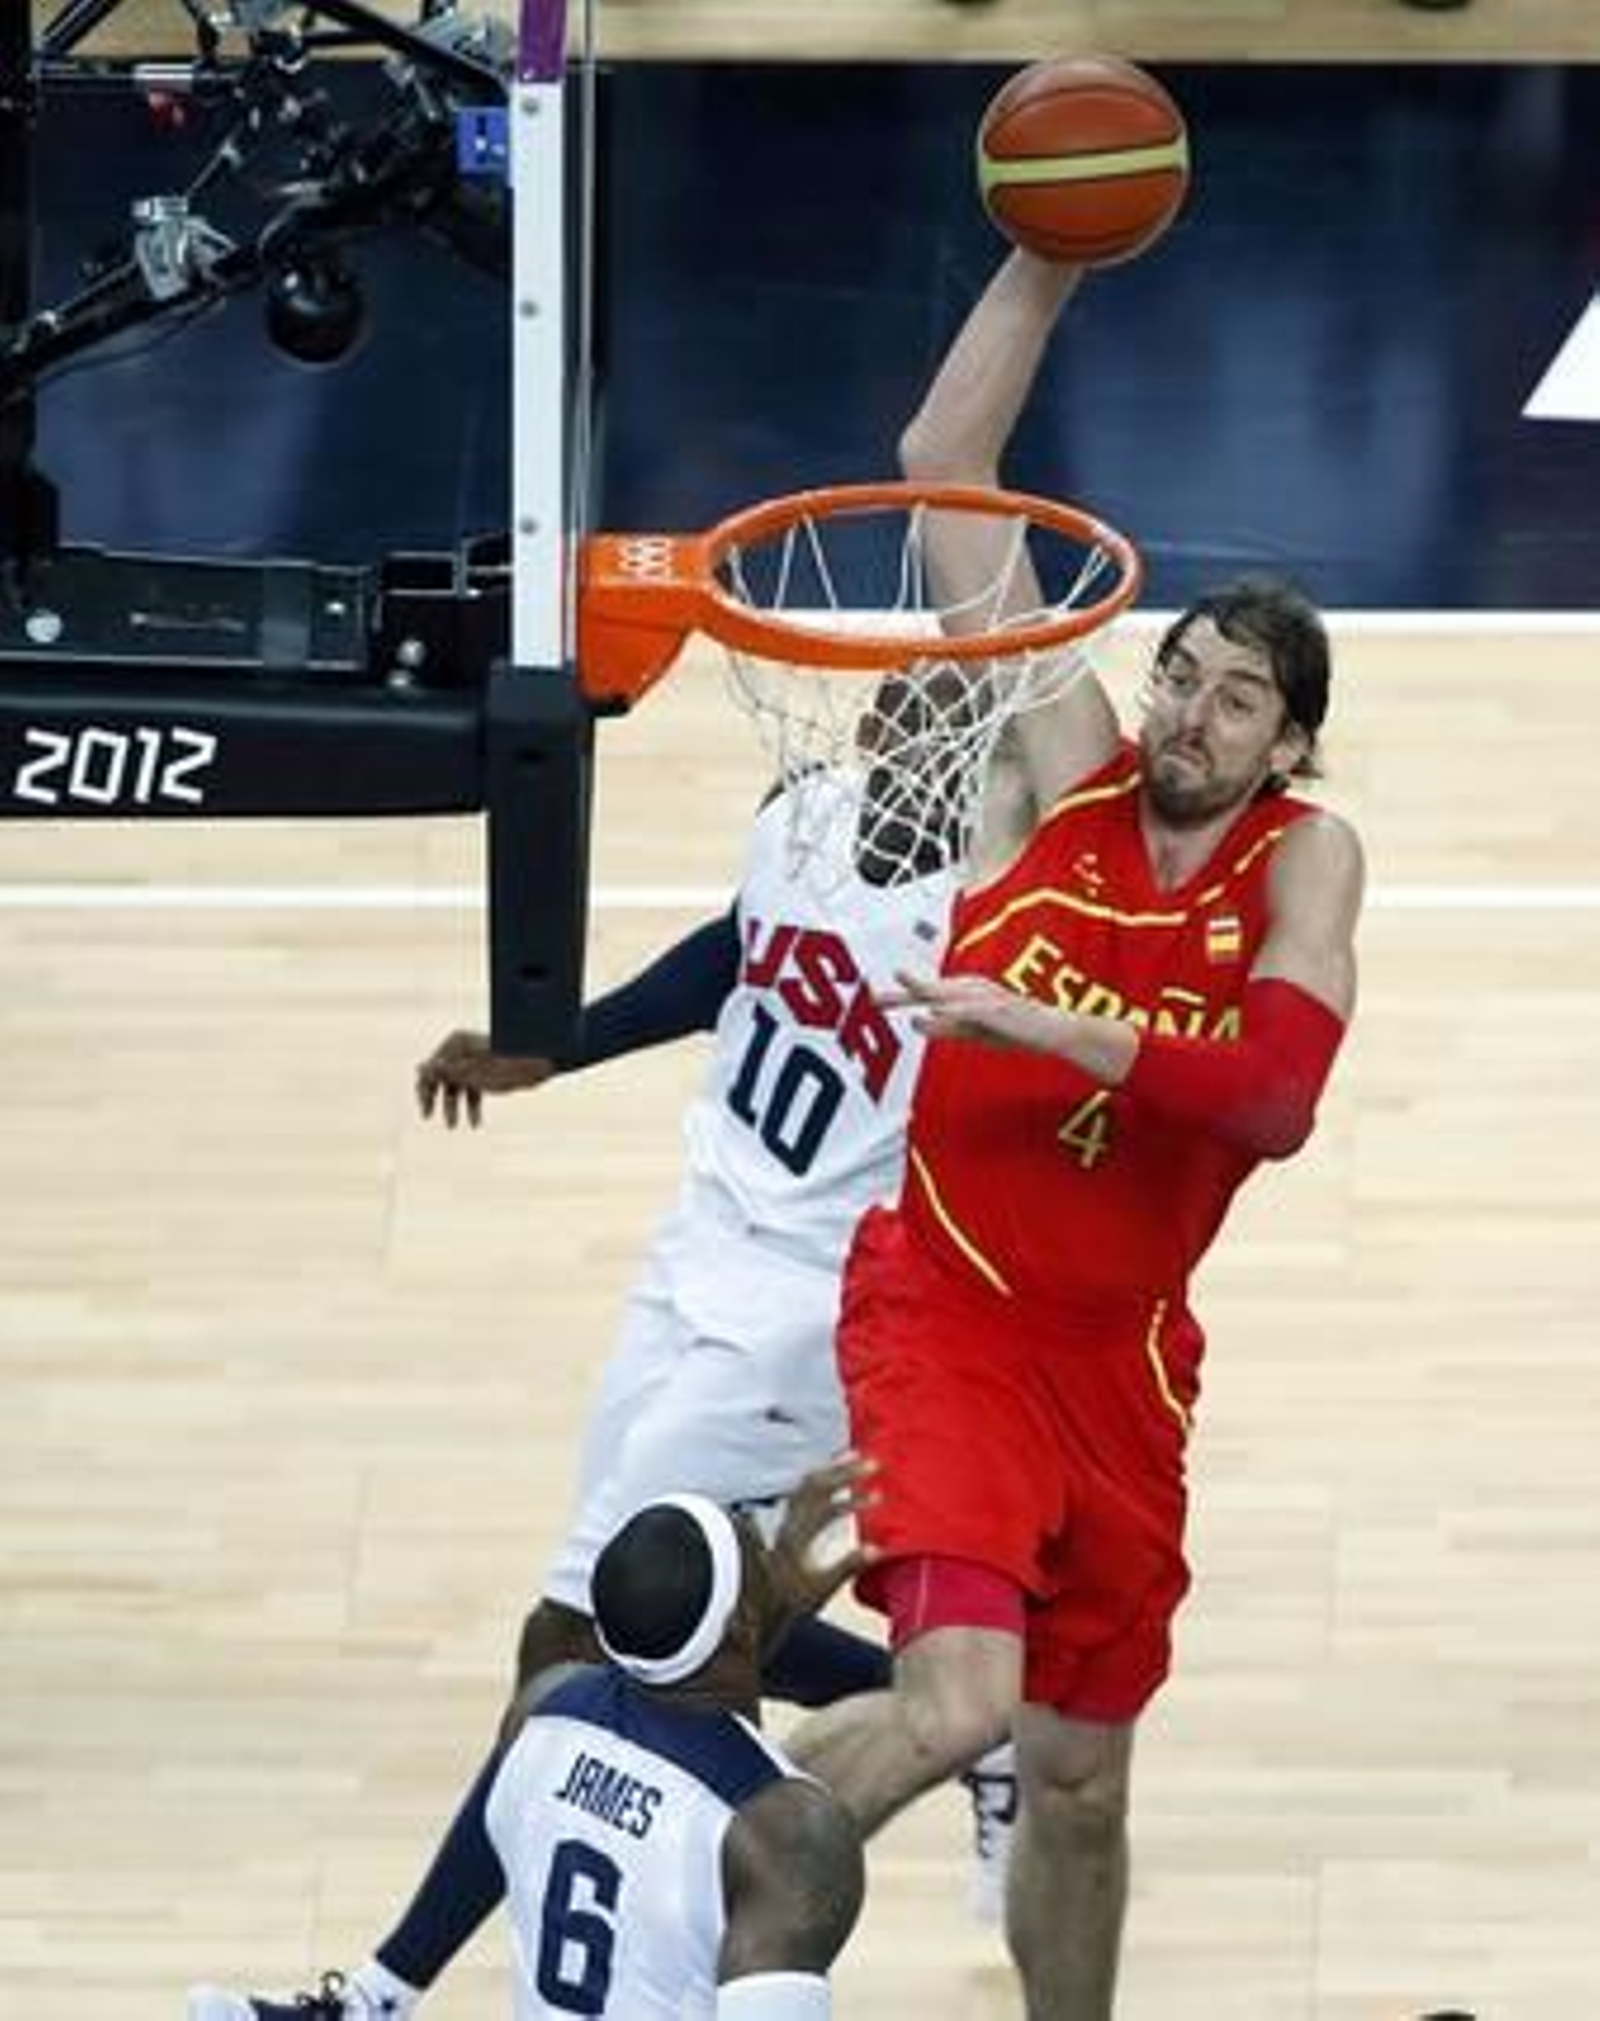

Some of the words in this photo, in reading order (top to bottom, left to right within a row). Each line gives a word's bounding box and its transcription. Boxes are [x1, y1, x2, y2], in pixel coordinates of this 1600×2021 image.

[15, 727, 217, 804] 2012
[743, 917, 903, 1106] USA
[727, 1000, 846, 1178] 10
[1058, 1089, 1109, 1169] 4
[554, 1752, 663, 1839] JAMES
[536, 1839, 623, 2015] 6
